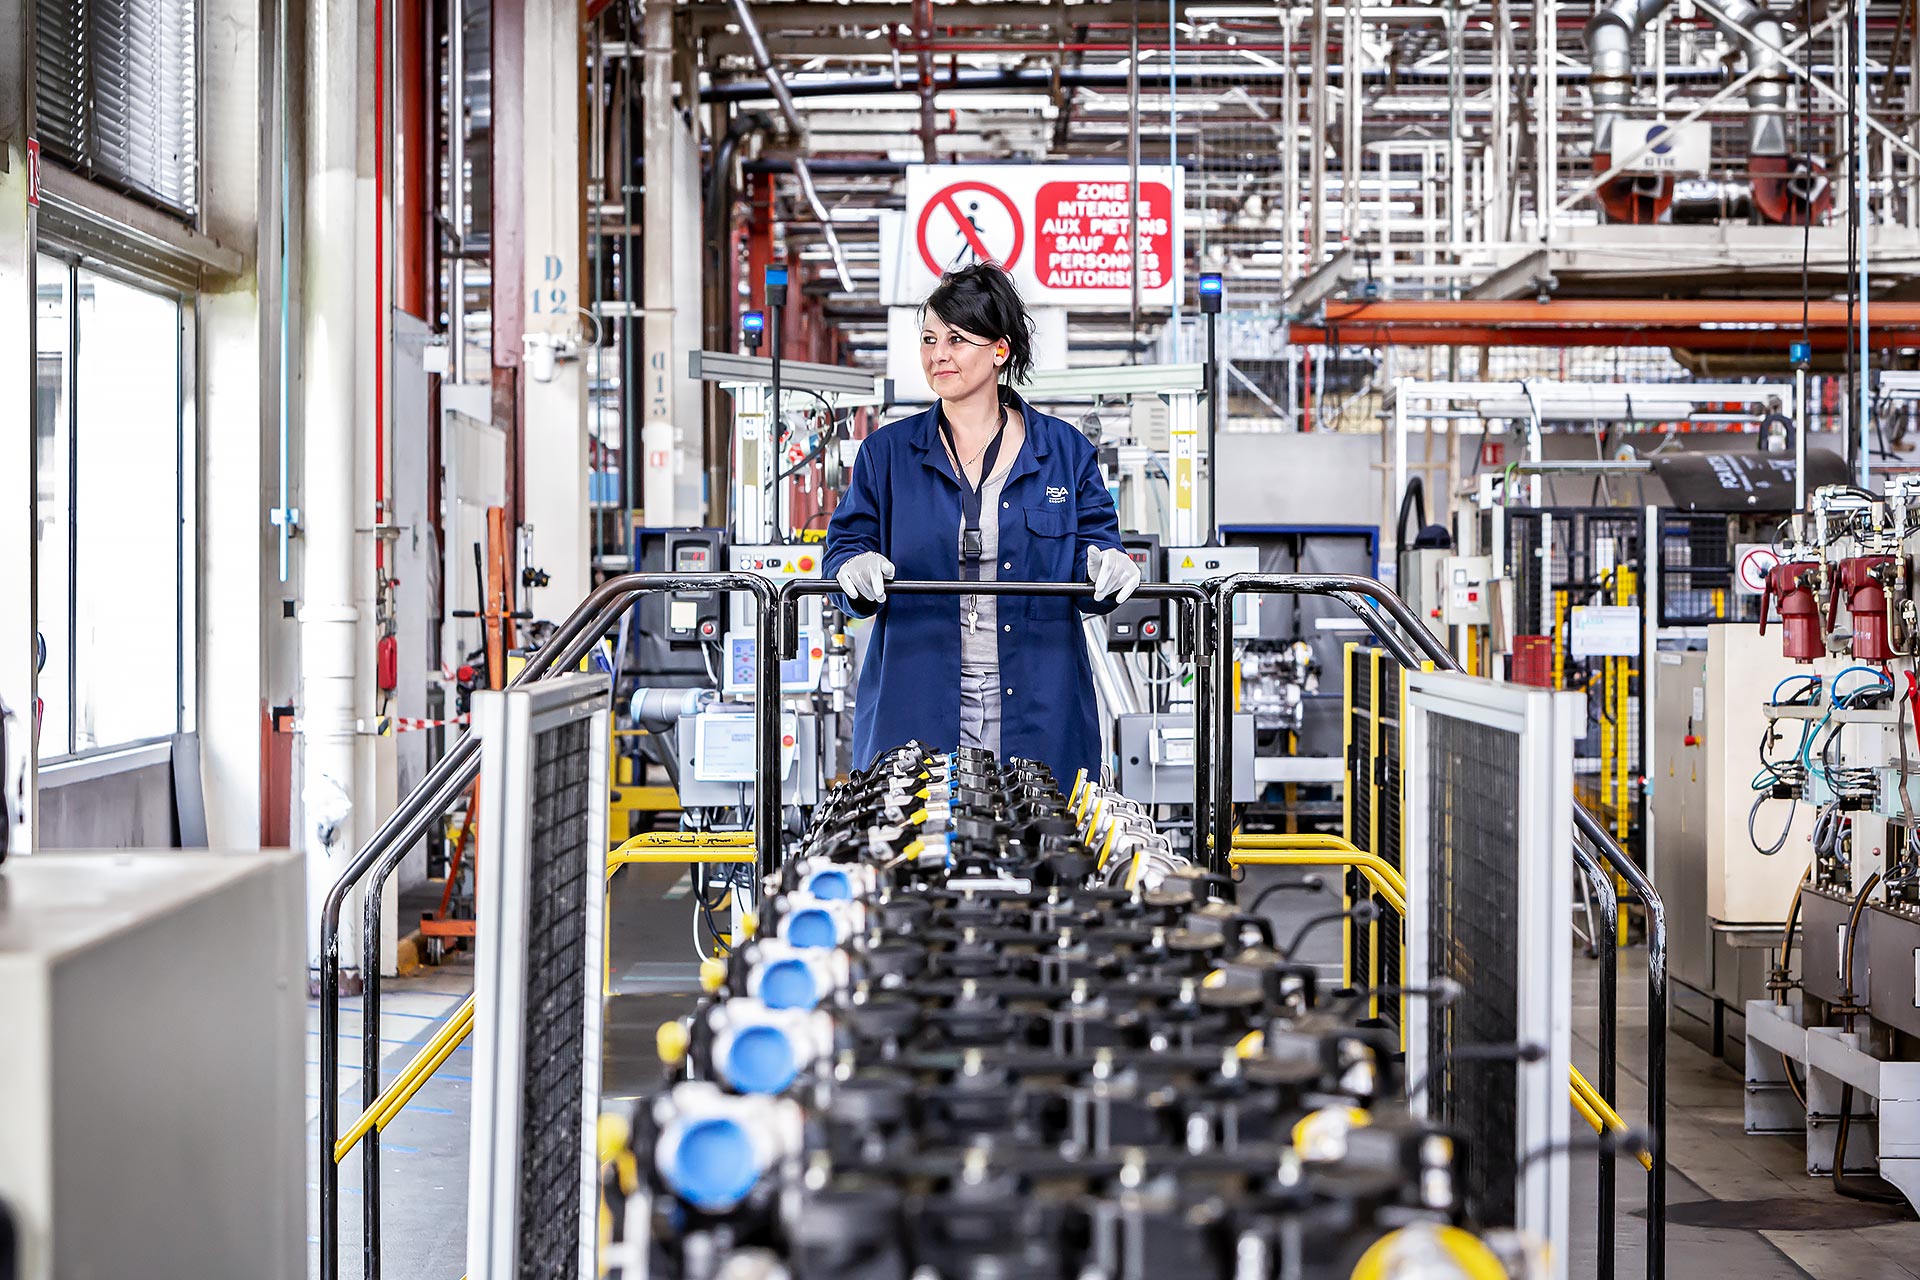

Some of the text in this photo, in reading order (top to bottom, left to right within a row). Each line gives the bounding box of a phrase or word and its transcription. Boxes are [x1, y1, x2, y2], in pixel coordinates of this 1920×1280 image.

[1076, 184, 1127, 200] ZONE
[1058, 201, 1151, 218] INTERDIE
[1041, 218, 1168, 236] AUX PIETNS
[1056, 235, 1104, 252] SAUF
[545, 254, 563, 280] D
[533, 288, 567, 314] 12
[1046, 485, 1069, 498] PSA
